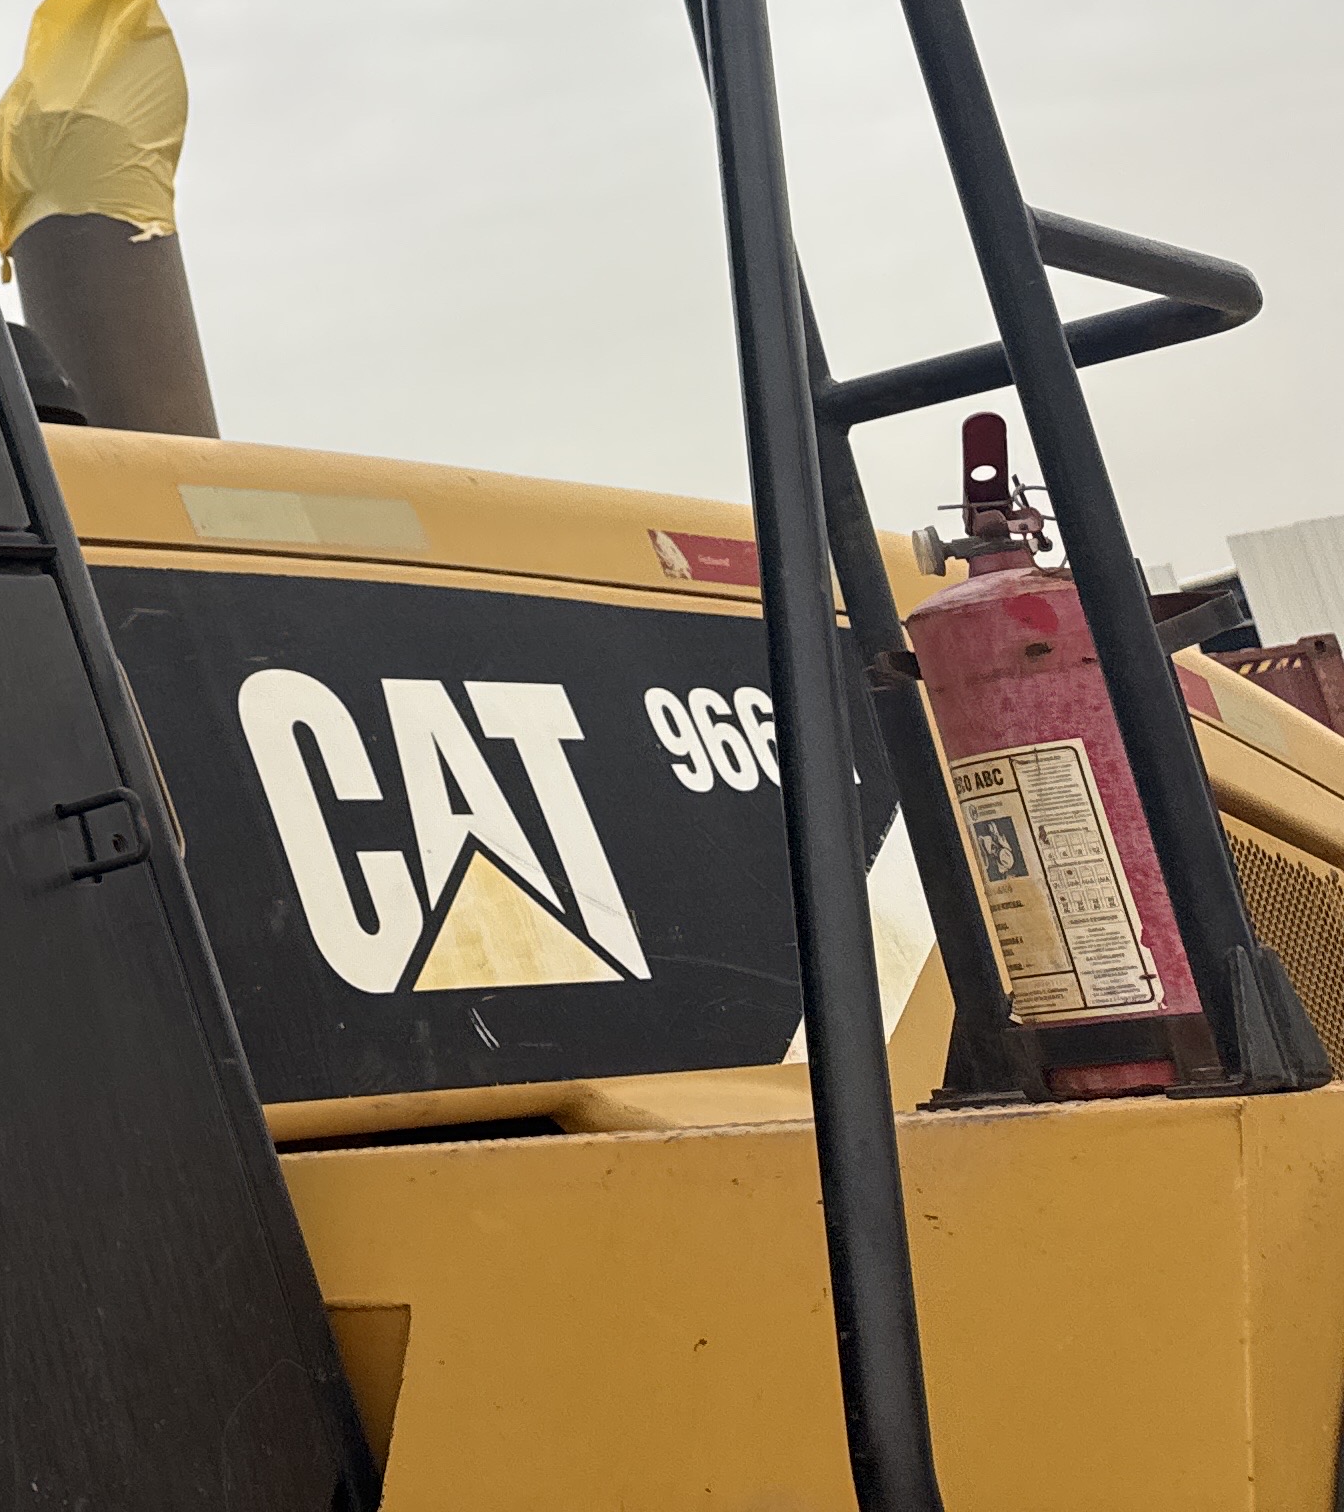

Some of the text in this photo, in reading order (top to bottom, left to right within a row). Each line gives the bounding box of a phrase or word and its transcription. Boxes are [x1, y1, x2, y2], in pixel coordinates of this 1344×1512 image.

[644, 686, 861, 793] 966
[974, 768, 1004, 791] ABC
[238, 669, 651, 994] CAT
